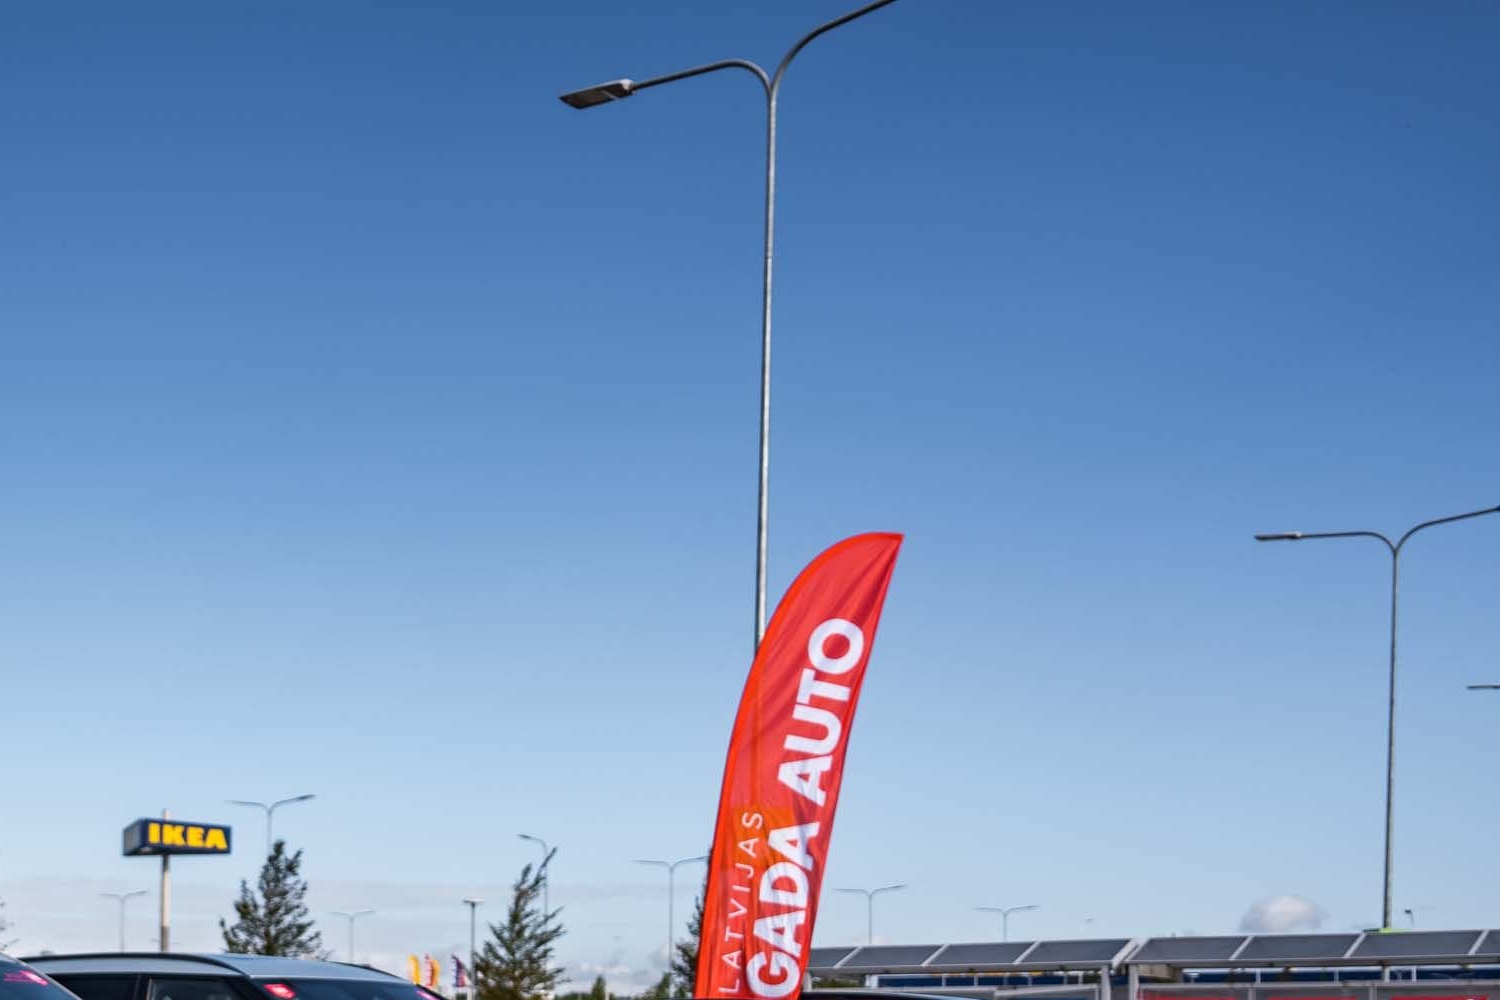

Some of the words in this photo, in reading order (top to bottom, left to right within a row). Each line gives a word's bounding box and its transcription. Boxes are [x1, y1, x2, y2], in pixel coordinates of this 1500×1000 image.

[777, 618, 864, 807] AUTO
[148, 822, 228, 849] IKEA
[719, 812, 763, 994] LATVIJAS
[746, 822, 820, 998] GADA
